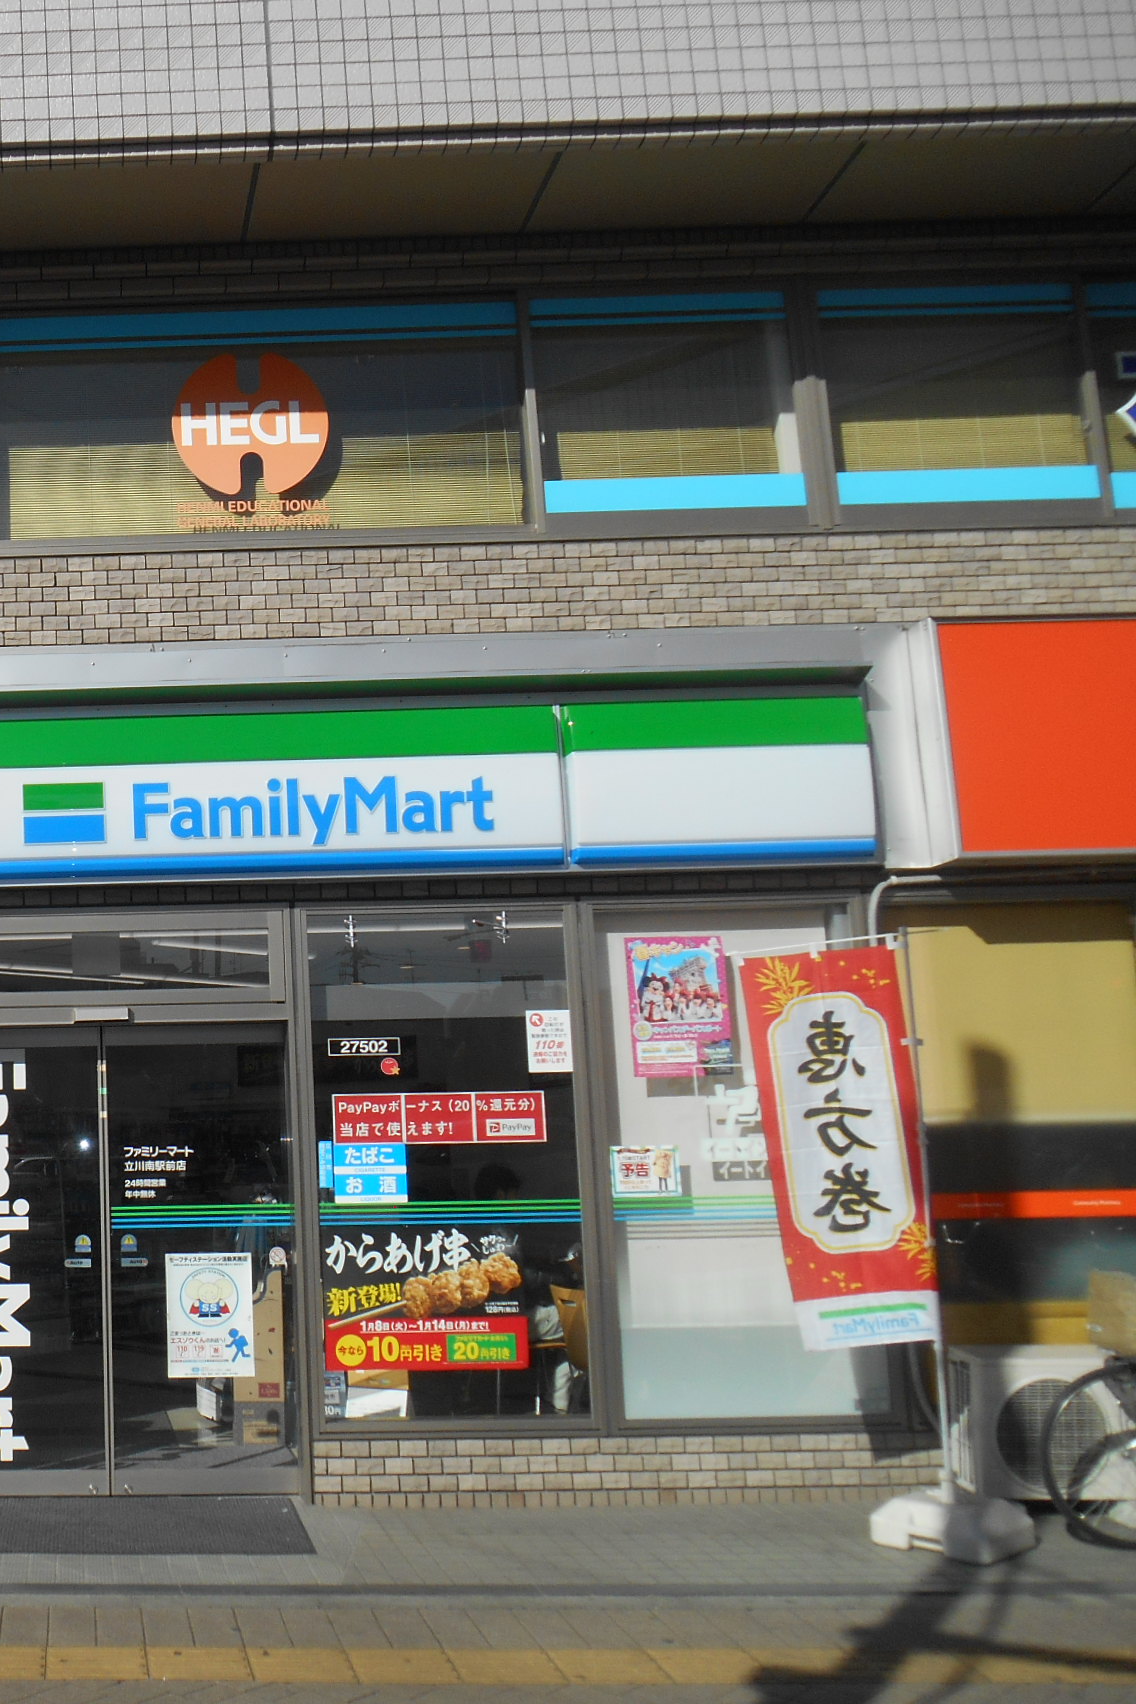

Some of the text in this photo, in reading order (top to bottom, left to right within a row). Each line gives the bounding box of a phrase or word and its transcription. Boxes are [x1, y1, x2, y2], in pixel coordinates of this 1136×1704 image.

[180, 400, 320, 447] HEGL
[228, 499, 331, 513] EDUCATIONAL
[132, 775, 495, 846] FamilyMart
[340, 1040, 388, 1054] 27502
[501, 1123, 531, 1132] PayPay
[124, 1146, 194, 1158] ファミリーマート
[345, 1147, 395, 1164] たばこ
[124, 1160, 187, 1171] 立川南駅前店
[621, 1163, 650, 1178] 予告
[325, 1228, 472, 1275] からあげ串
[327, 1283, 402, 1316] 新登場!
[201, 1304, 218, 1312] SS
[338, 1345, 365, 1356] 今なら
[367, 1336, 443, 1362] 10円引き
[454, 1343, 510, 1360] 20円引き
